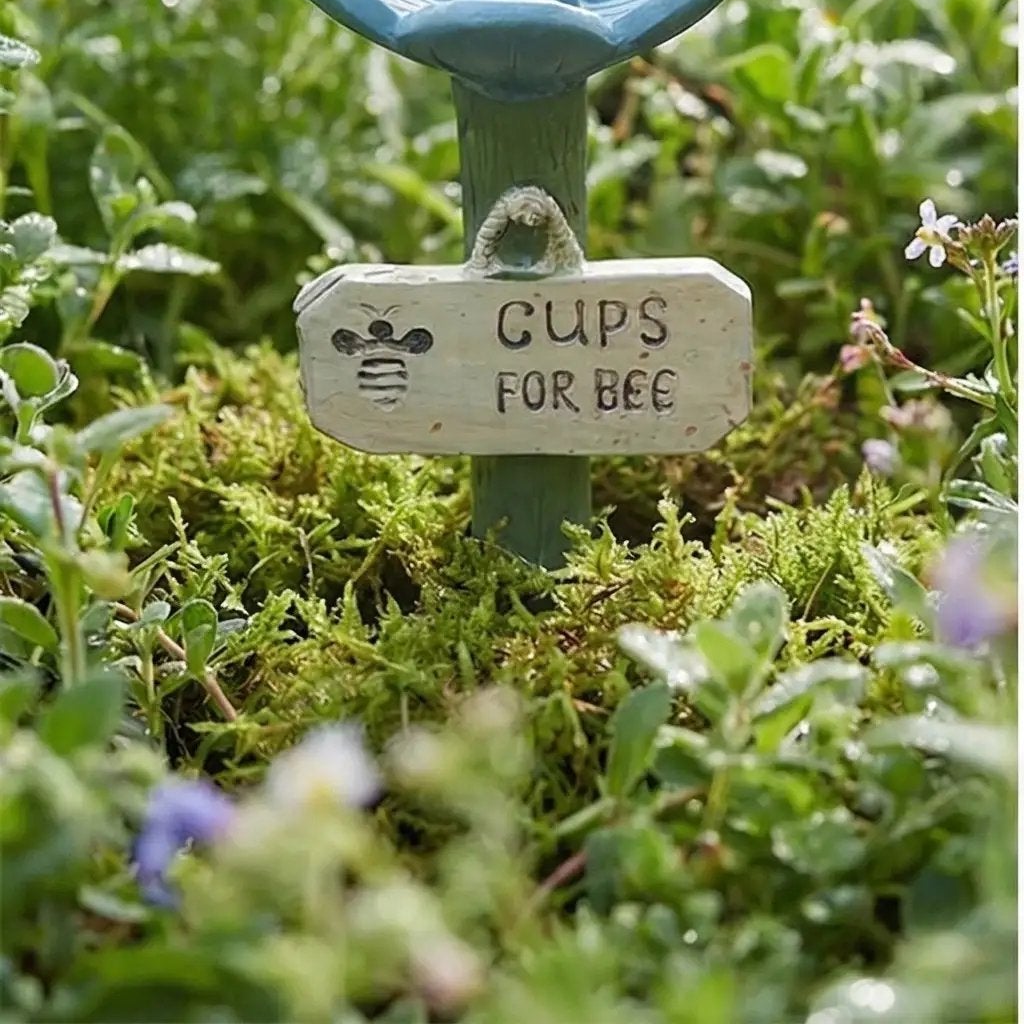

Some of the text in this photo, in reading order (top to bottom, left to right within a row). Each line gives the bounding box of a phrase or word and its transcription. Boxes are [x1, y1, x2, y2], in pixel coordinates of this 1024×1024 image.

[496, 296, 670, 350] CUPS
[496, 368, 678, 414] FOR BEE
